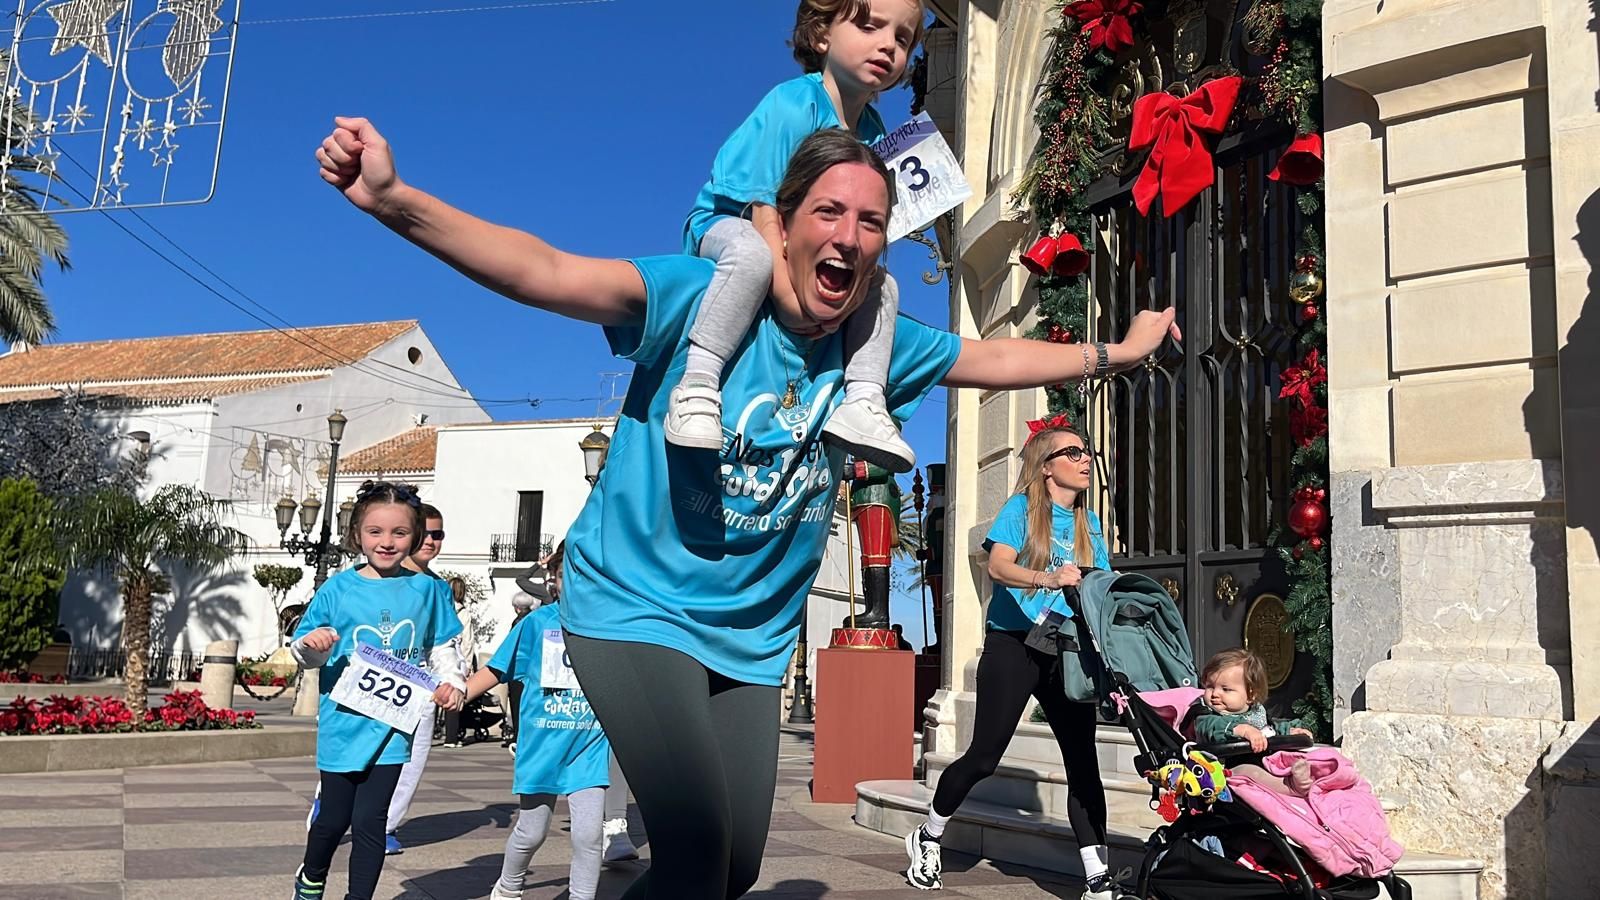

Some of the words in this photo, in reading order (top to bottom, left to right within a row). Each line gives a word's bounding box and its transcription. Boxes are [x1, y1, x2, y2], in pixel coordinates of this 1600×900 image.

[724, 432, 775, 468] Nos
[713, 464, 830, 502] cuidrte
[711, 503, 770, 532] carrera
[358, 668, 412, 707] 529
[546, 720, 576, 730] carrera
